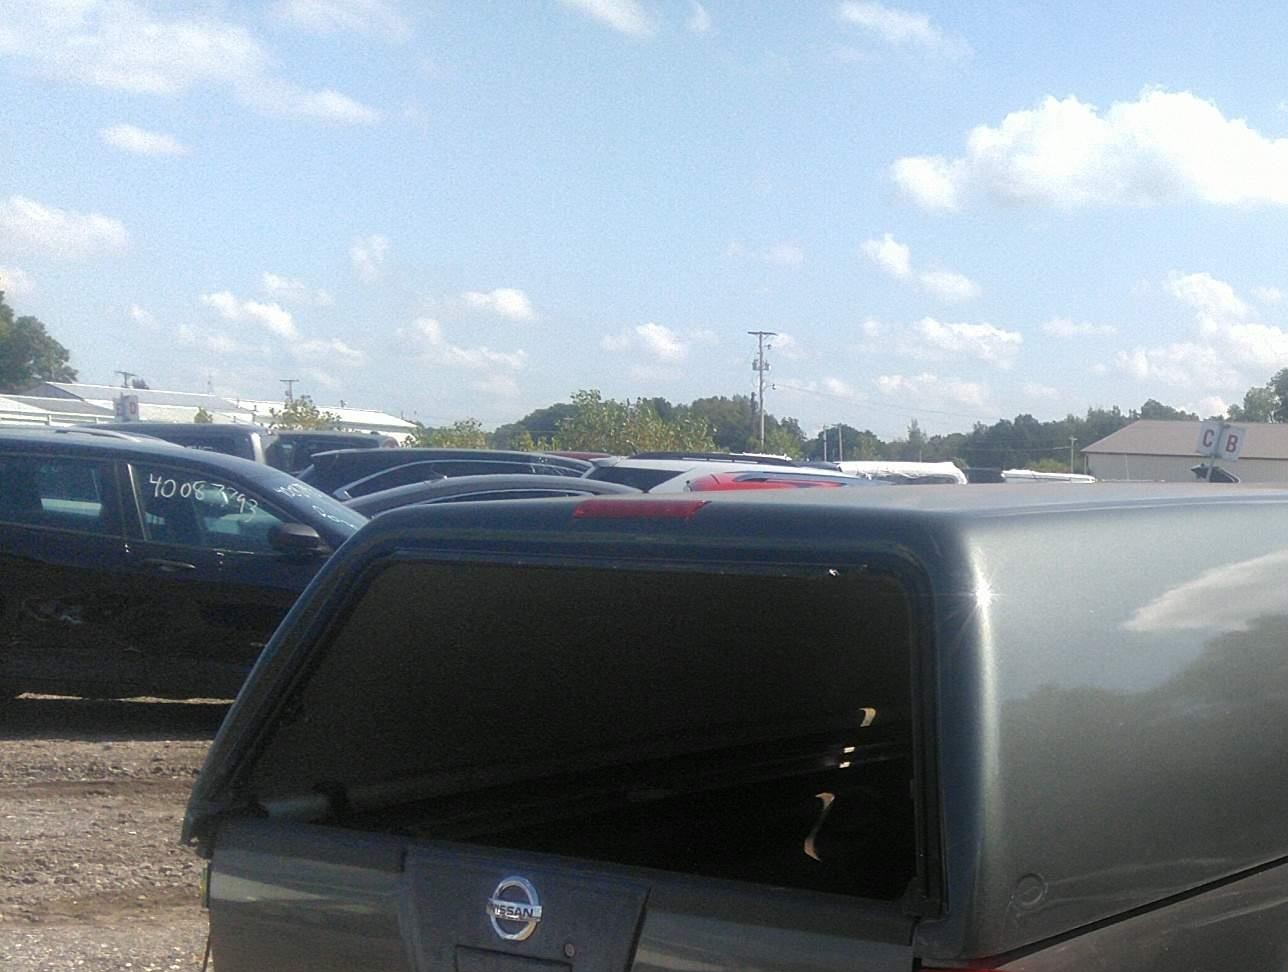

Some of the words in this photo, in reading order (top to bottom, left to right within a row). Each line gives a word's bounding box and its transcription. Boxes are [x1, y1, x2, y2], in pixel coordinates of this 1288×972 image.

[1202, 429, 1215, 448] C
[1225, 434, 1239, 453] B
[491, 902, 534, 918] NISSAN
